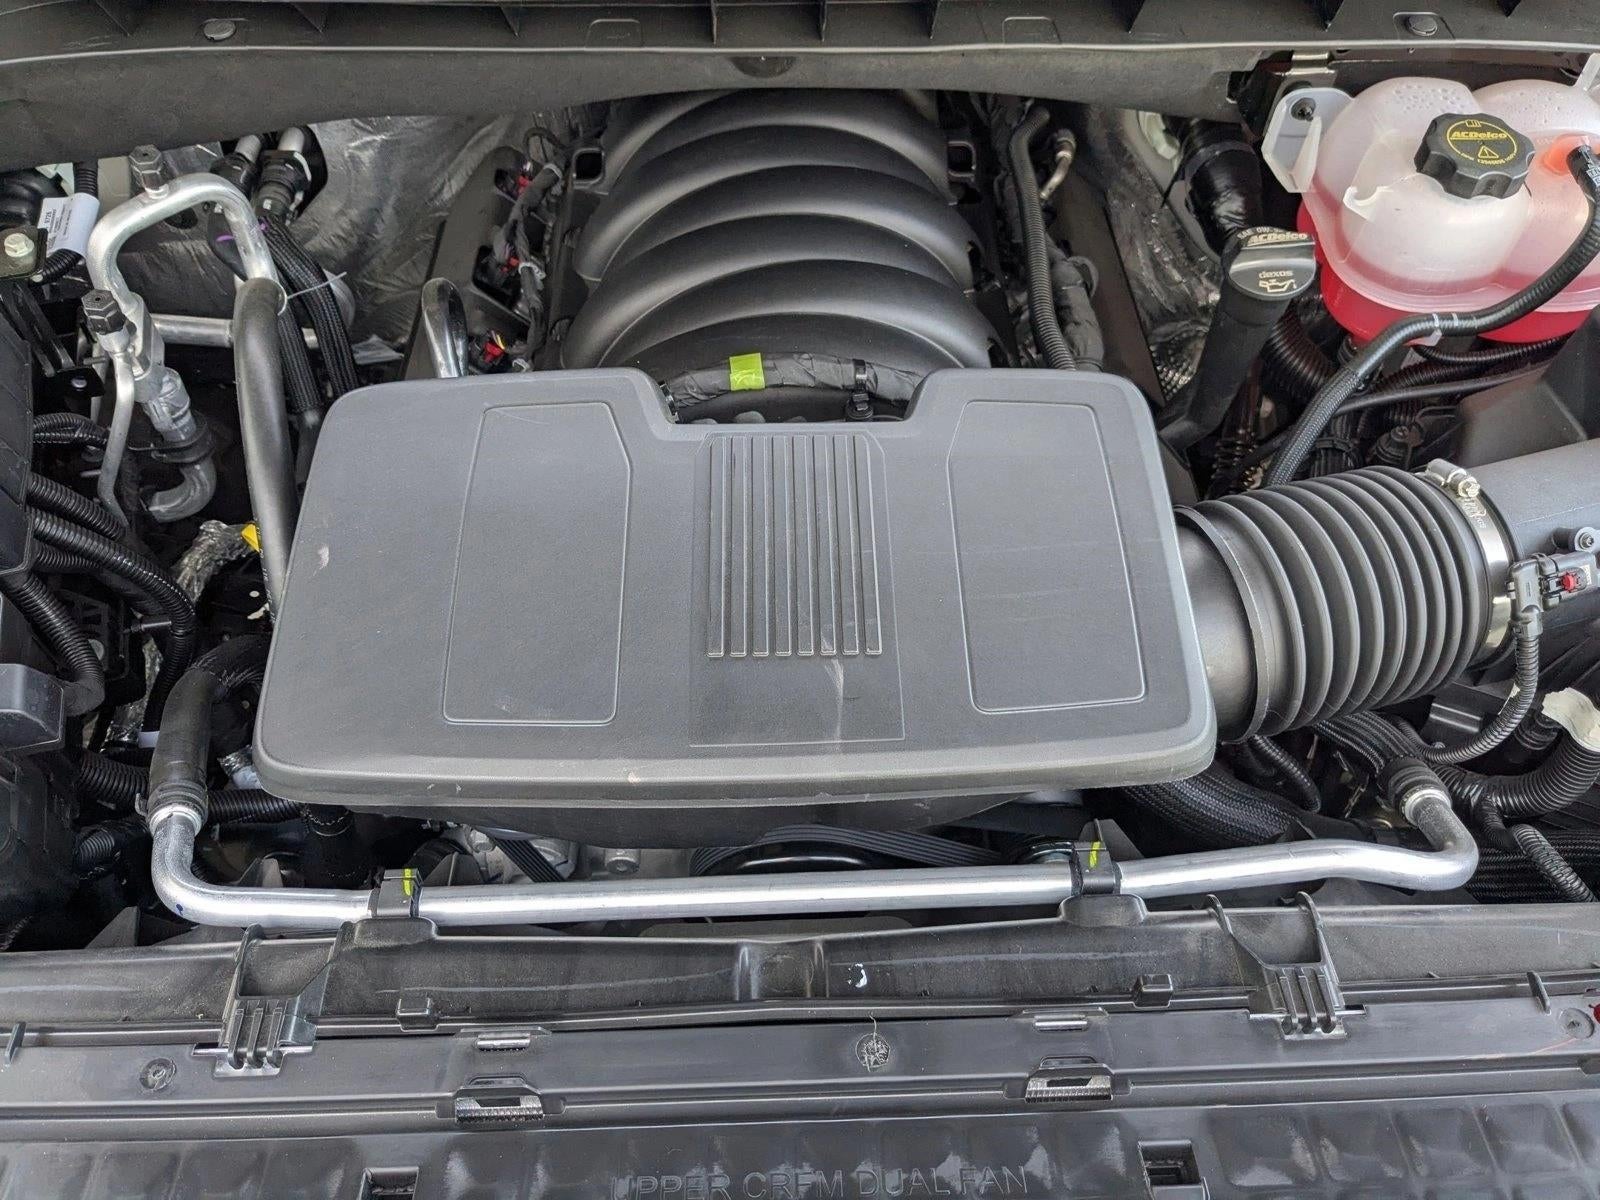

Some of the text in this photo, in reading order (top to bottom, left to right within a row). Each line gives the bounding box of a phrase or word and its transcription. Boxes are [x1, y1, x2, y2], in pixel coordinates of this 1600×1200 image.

[1450, 131, 1507, 139] ACDelco
[1247, 233, 1308, 246] ACDelco
[611, 1165, 1028, 1200] UPPER CRFM DUAL FAN
